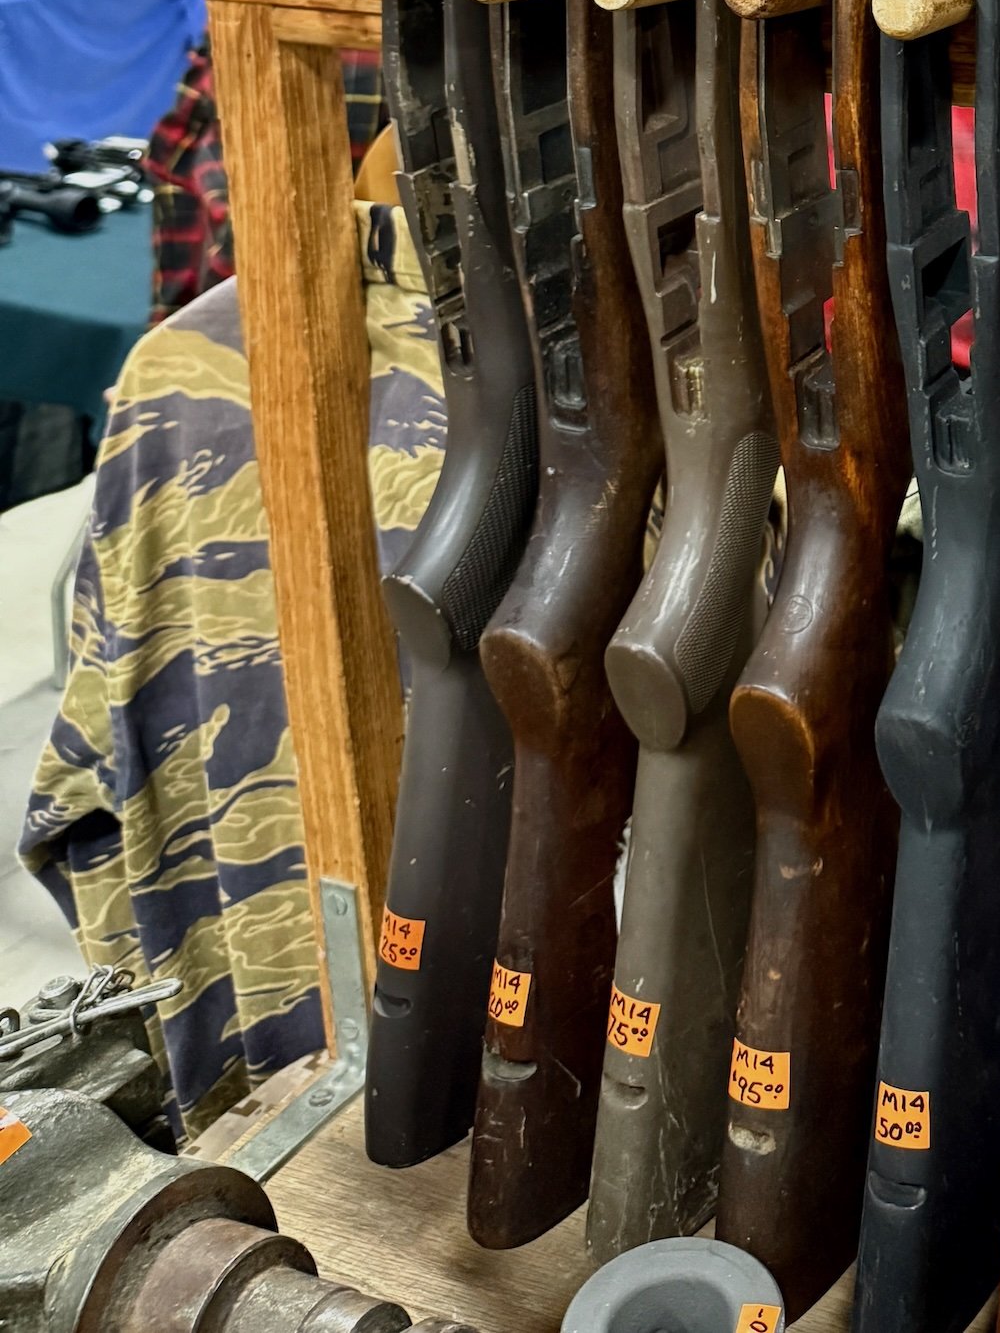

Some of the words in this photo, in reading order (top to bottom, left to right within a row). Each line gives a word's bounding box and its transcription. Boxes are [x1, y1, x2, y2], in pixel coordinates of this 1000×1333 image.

[493, 968, 521, 995] M14
[611, 993, 652, 1025] M14
[736, 1047, 774, 1075] M14
[882, 1090, 925, 1113] M14
